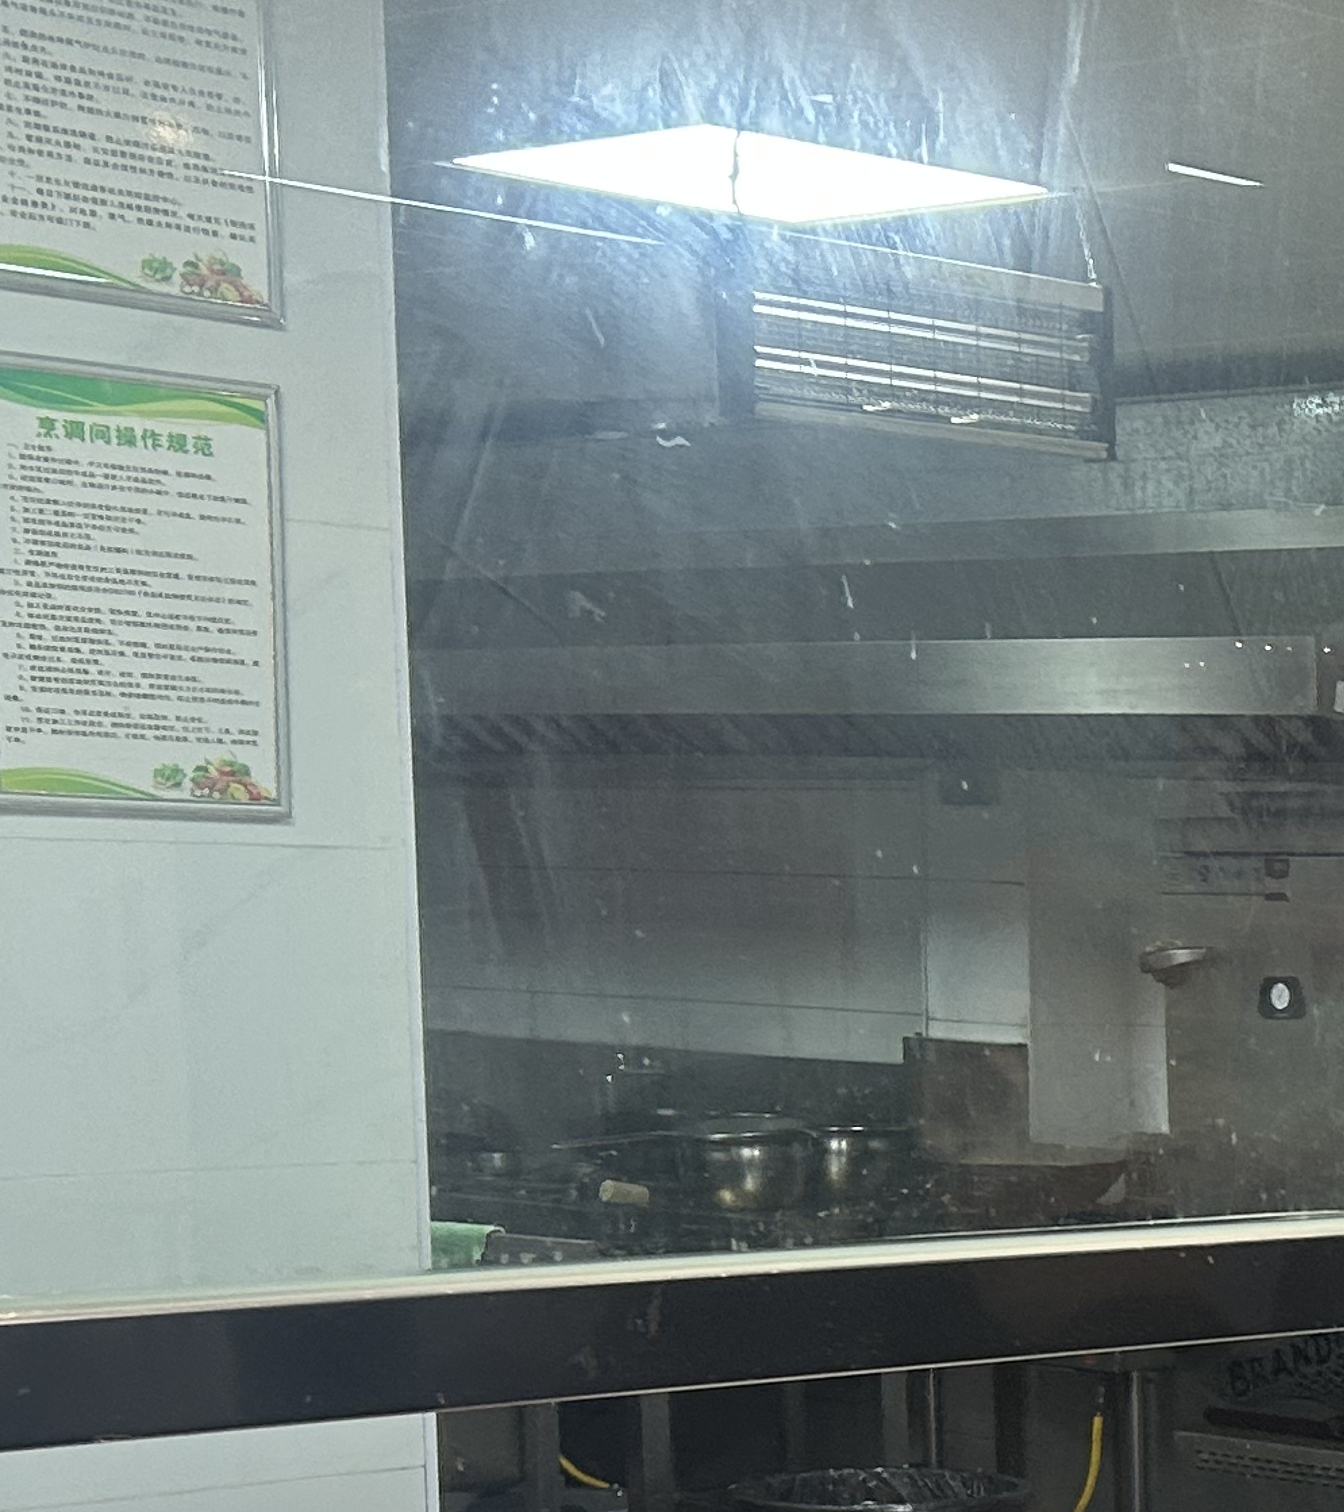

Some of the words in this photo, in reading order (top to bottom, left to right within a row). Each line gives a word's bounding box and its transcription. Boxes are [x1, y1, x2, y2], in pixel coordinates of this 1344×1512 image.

[35, 415, 215, 458] 烹调间操作规范
